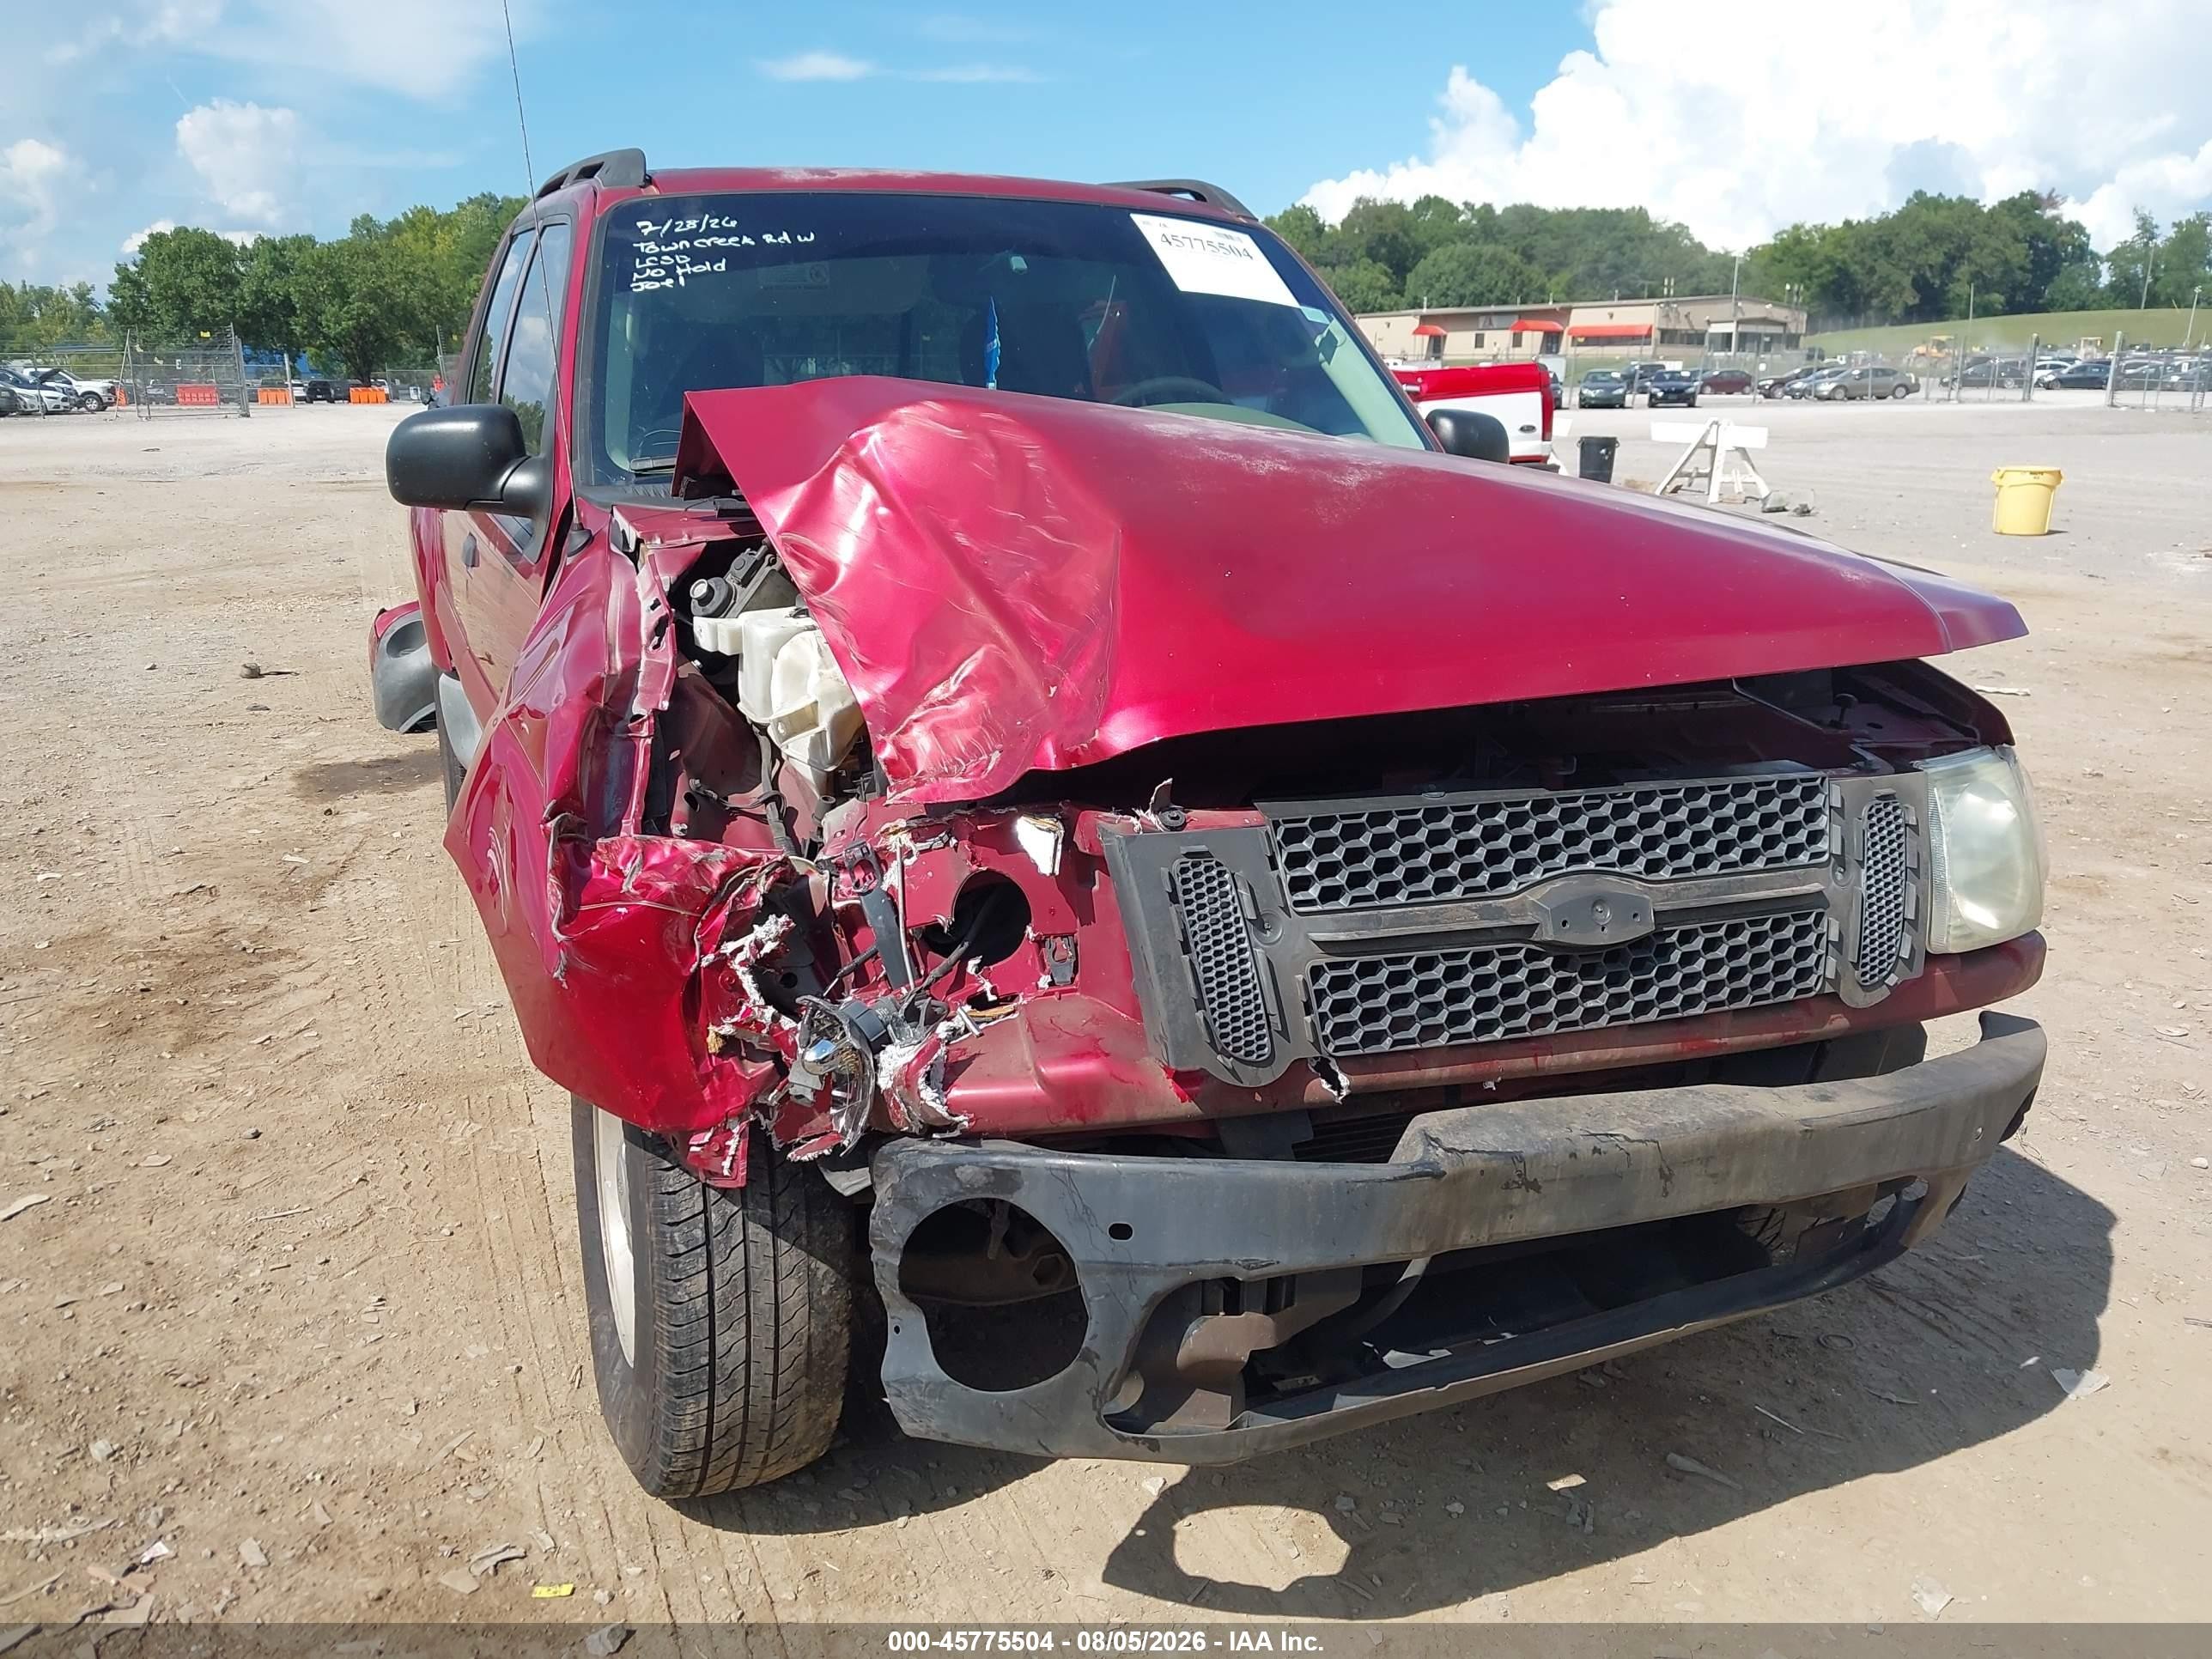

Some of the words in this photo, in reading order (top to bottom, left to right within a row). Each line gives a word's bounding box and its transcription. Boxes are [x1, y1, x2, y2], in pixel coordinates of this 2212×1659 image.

[635, 214, 738, 238] 7/28/26
[762, 230, 792, 245] Rd
[1160, 233, 1254, 260] 45775504
[676, 258, 726, 276] Hold
